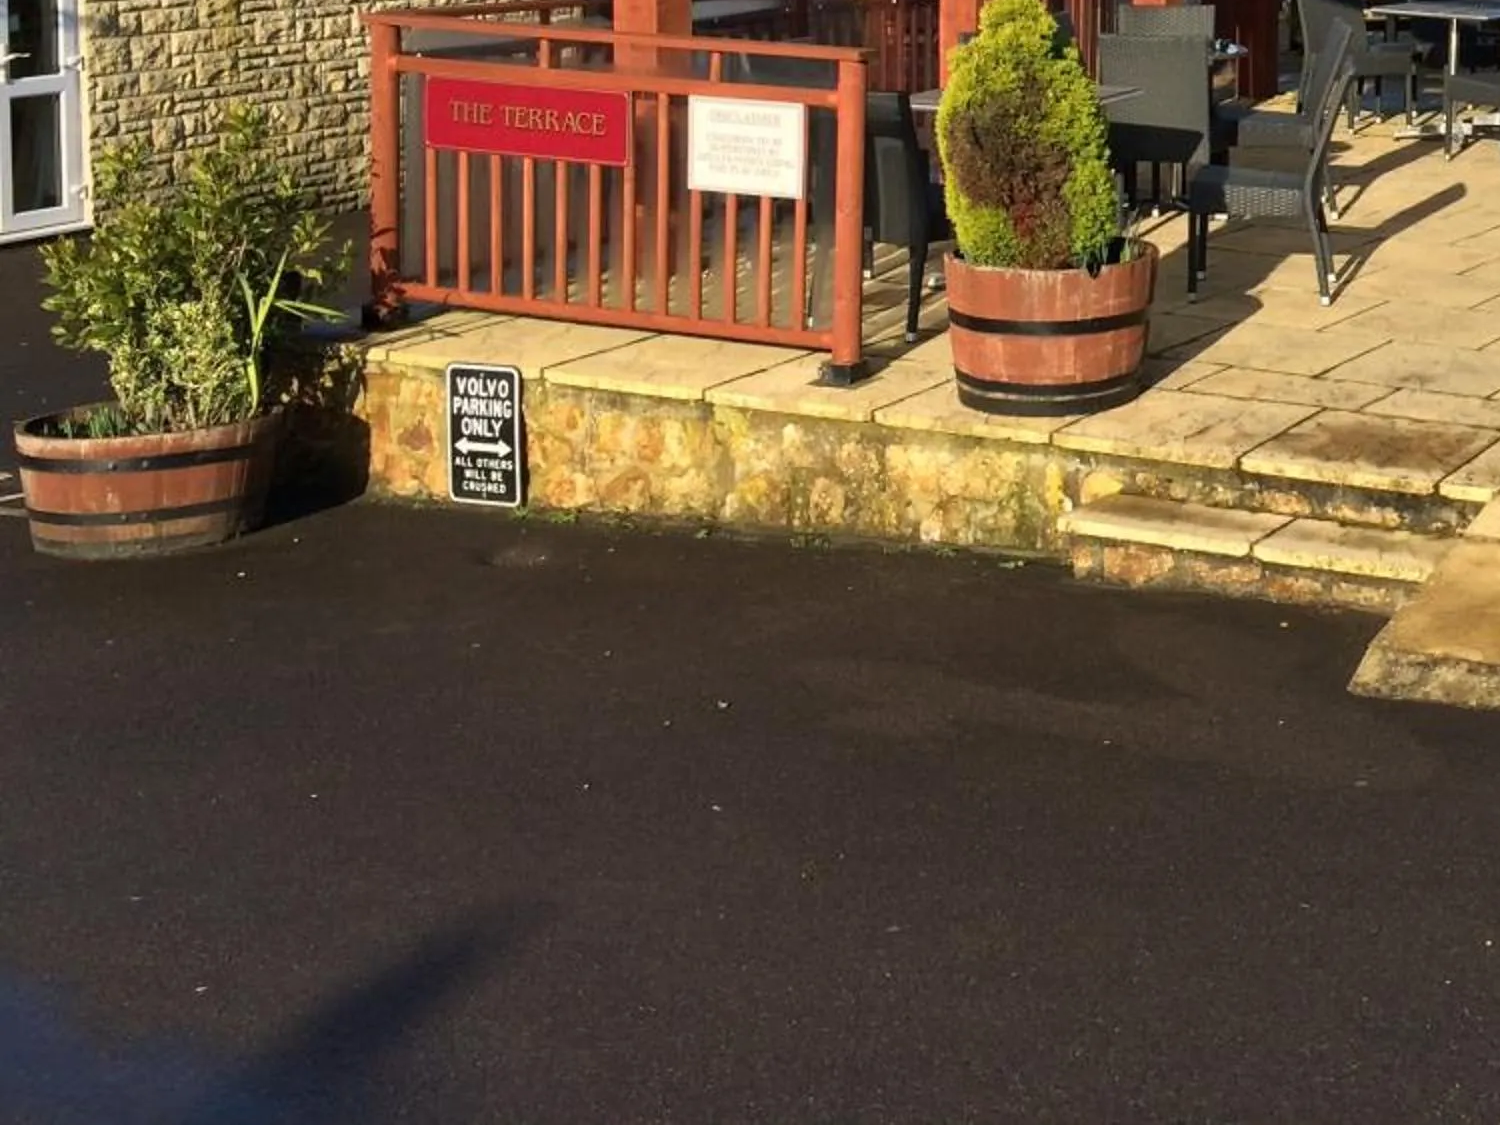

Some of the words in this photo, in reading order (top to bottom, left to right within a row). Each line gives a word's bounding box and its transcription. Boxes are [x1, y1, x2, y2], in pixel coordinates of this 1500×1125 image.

[449, 100, 492, 124] THE
[501, 106, 606, 136] TERRACE
[456, 377, 509, 398] VOLVO
[453, 397, 512, 419] PARKING
[461, 417, 503, 437] ONLY
[455, 456, 473, 467] ALL
[476, 458, 513, 471] OTHERS
[464, 469, 487, 480] WILL
[491, 471, 503, 482] BE
[462, 481, 507, 494] CRUSHED
